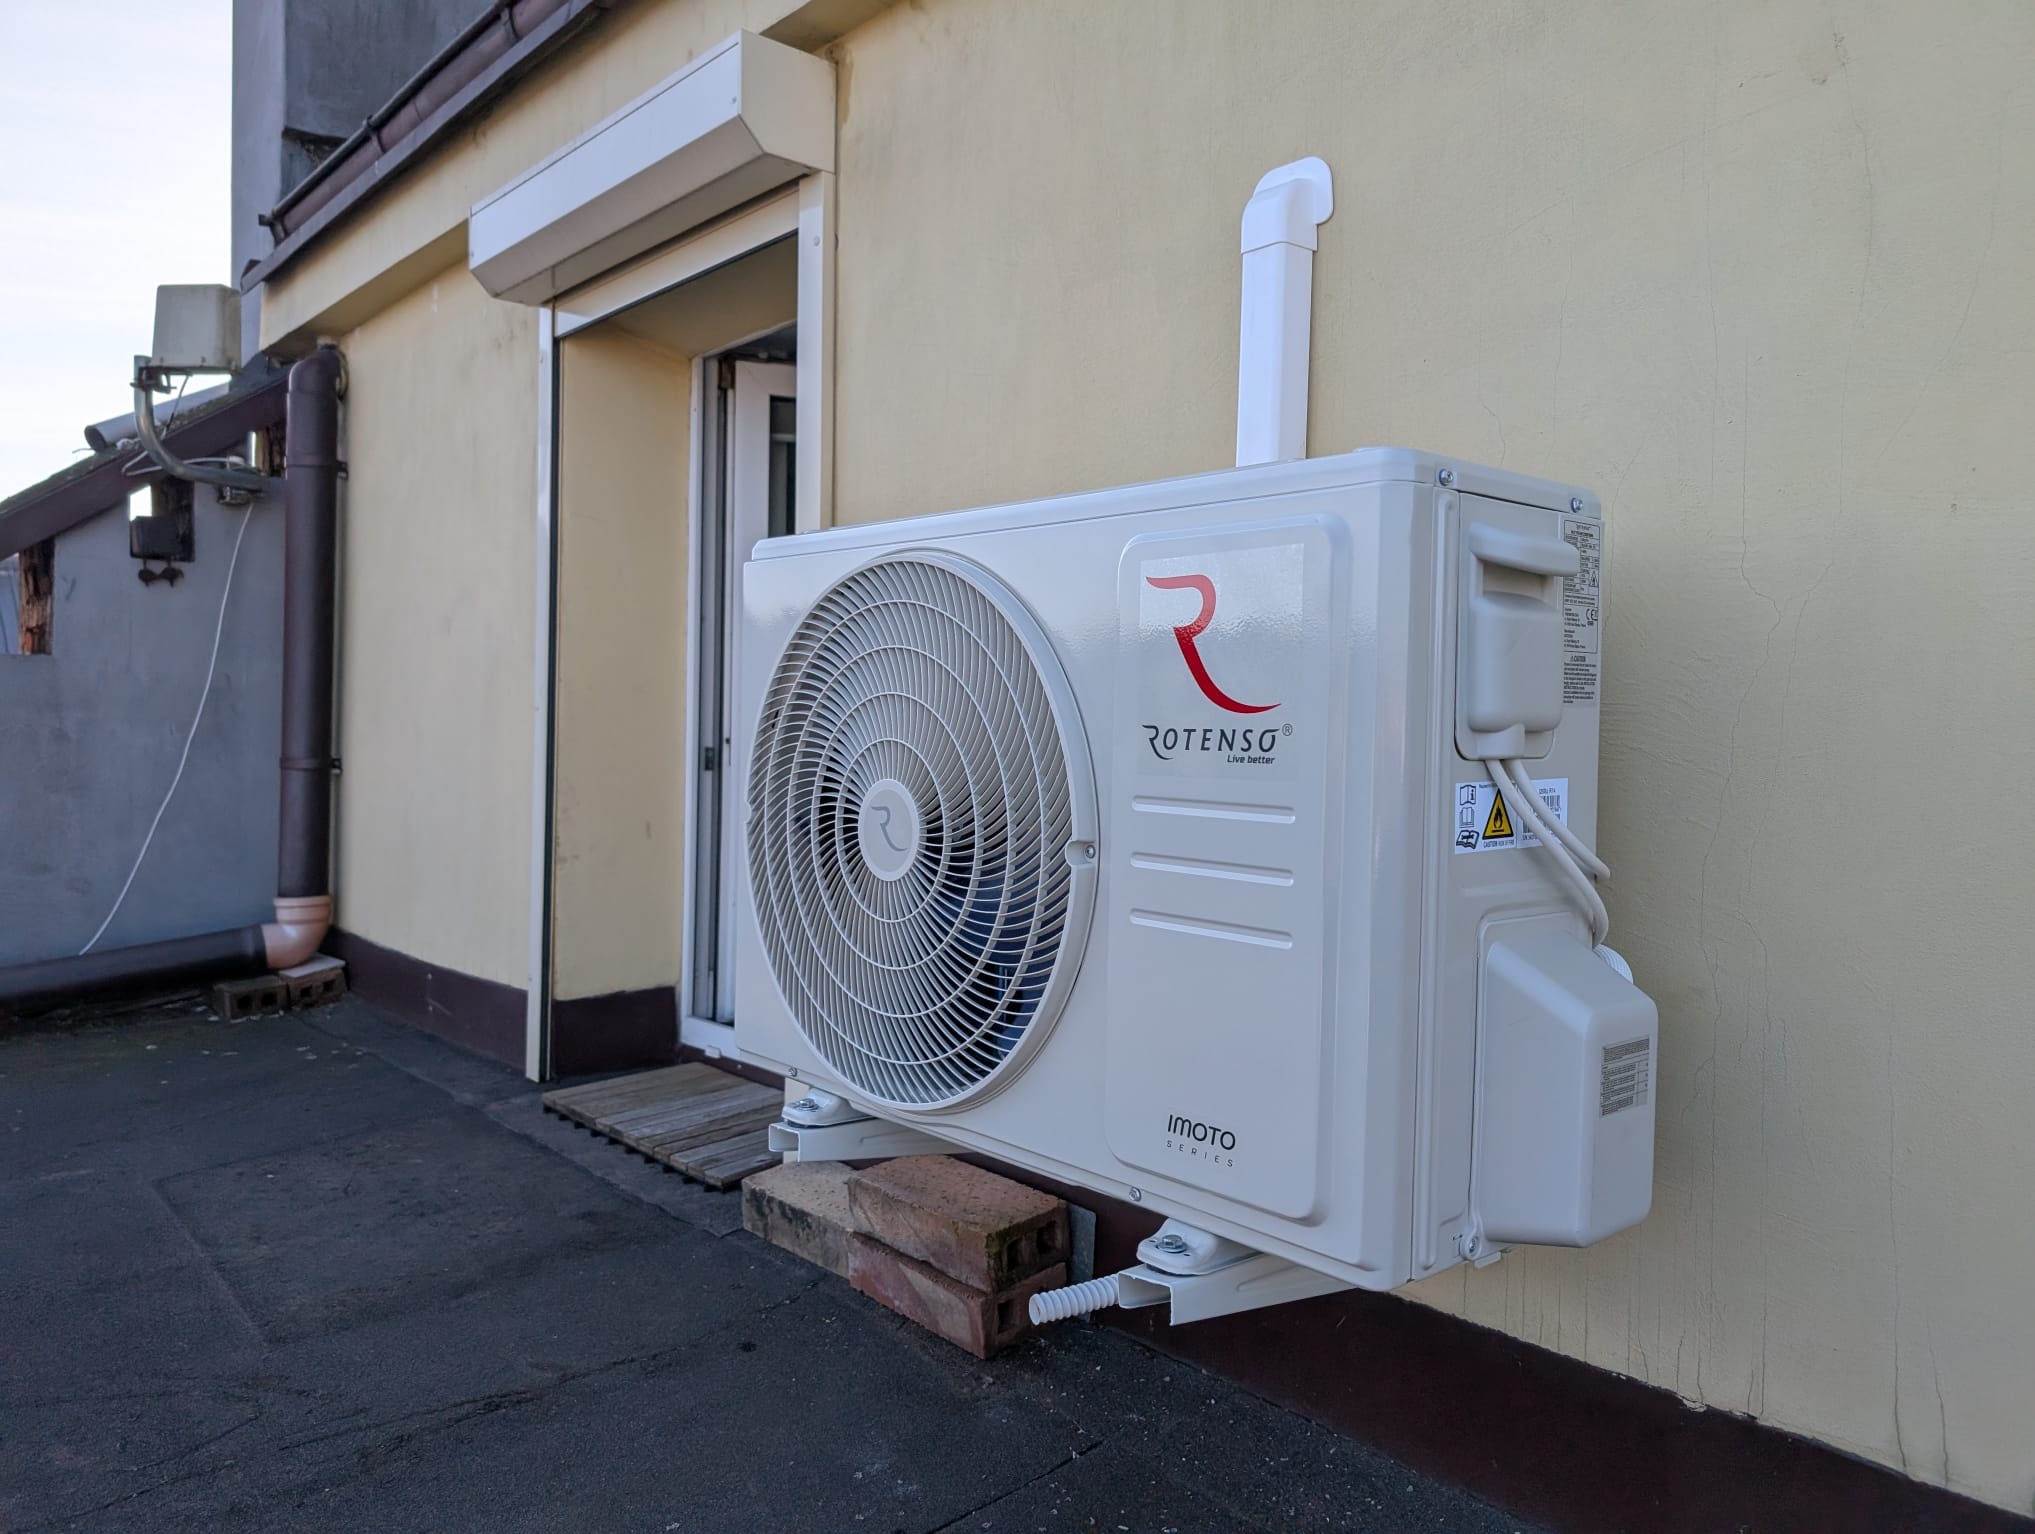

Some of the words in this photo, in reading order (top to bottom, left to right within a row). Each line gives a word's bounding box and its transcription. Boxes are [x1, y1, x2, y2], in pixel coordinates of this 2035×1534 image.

[1227, 754, 1245, 764] Live
[1247, 754, 1275, 765] better
[1167, 1114, 1236, 1151] IMOTO
[1166, 1140, 1233, 1168] SERIES
